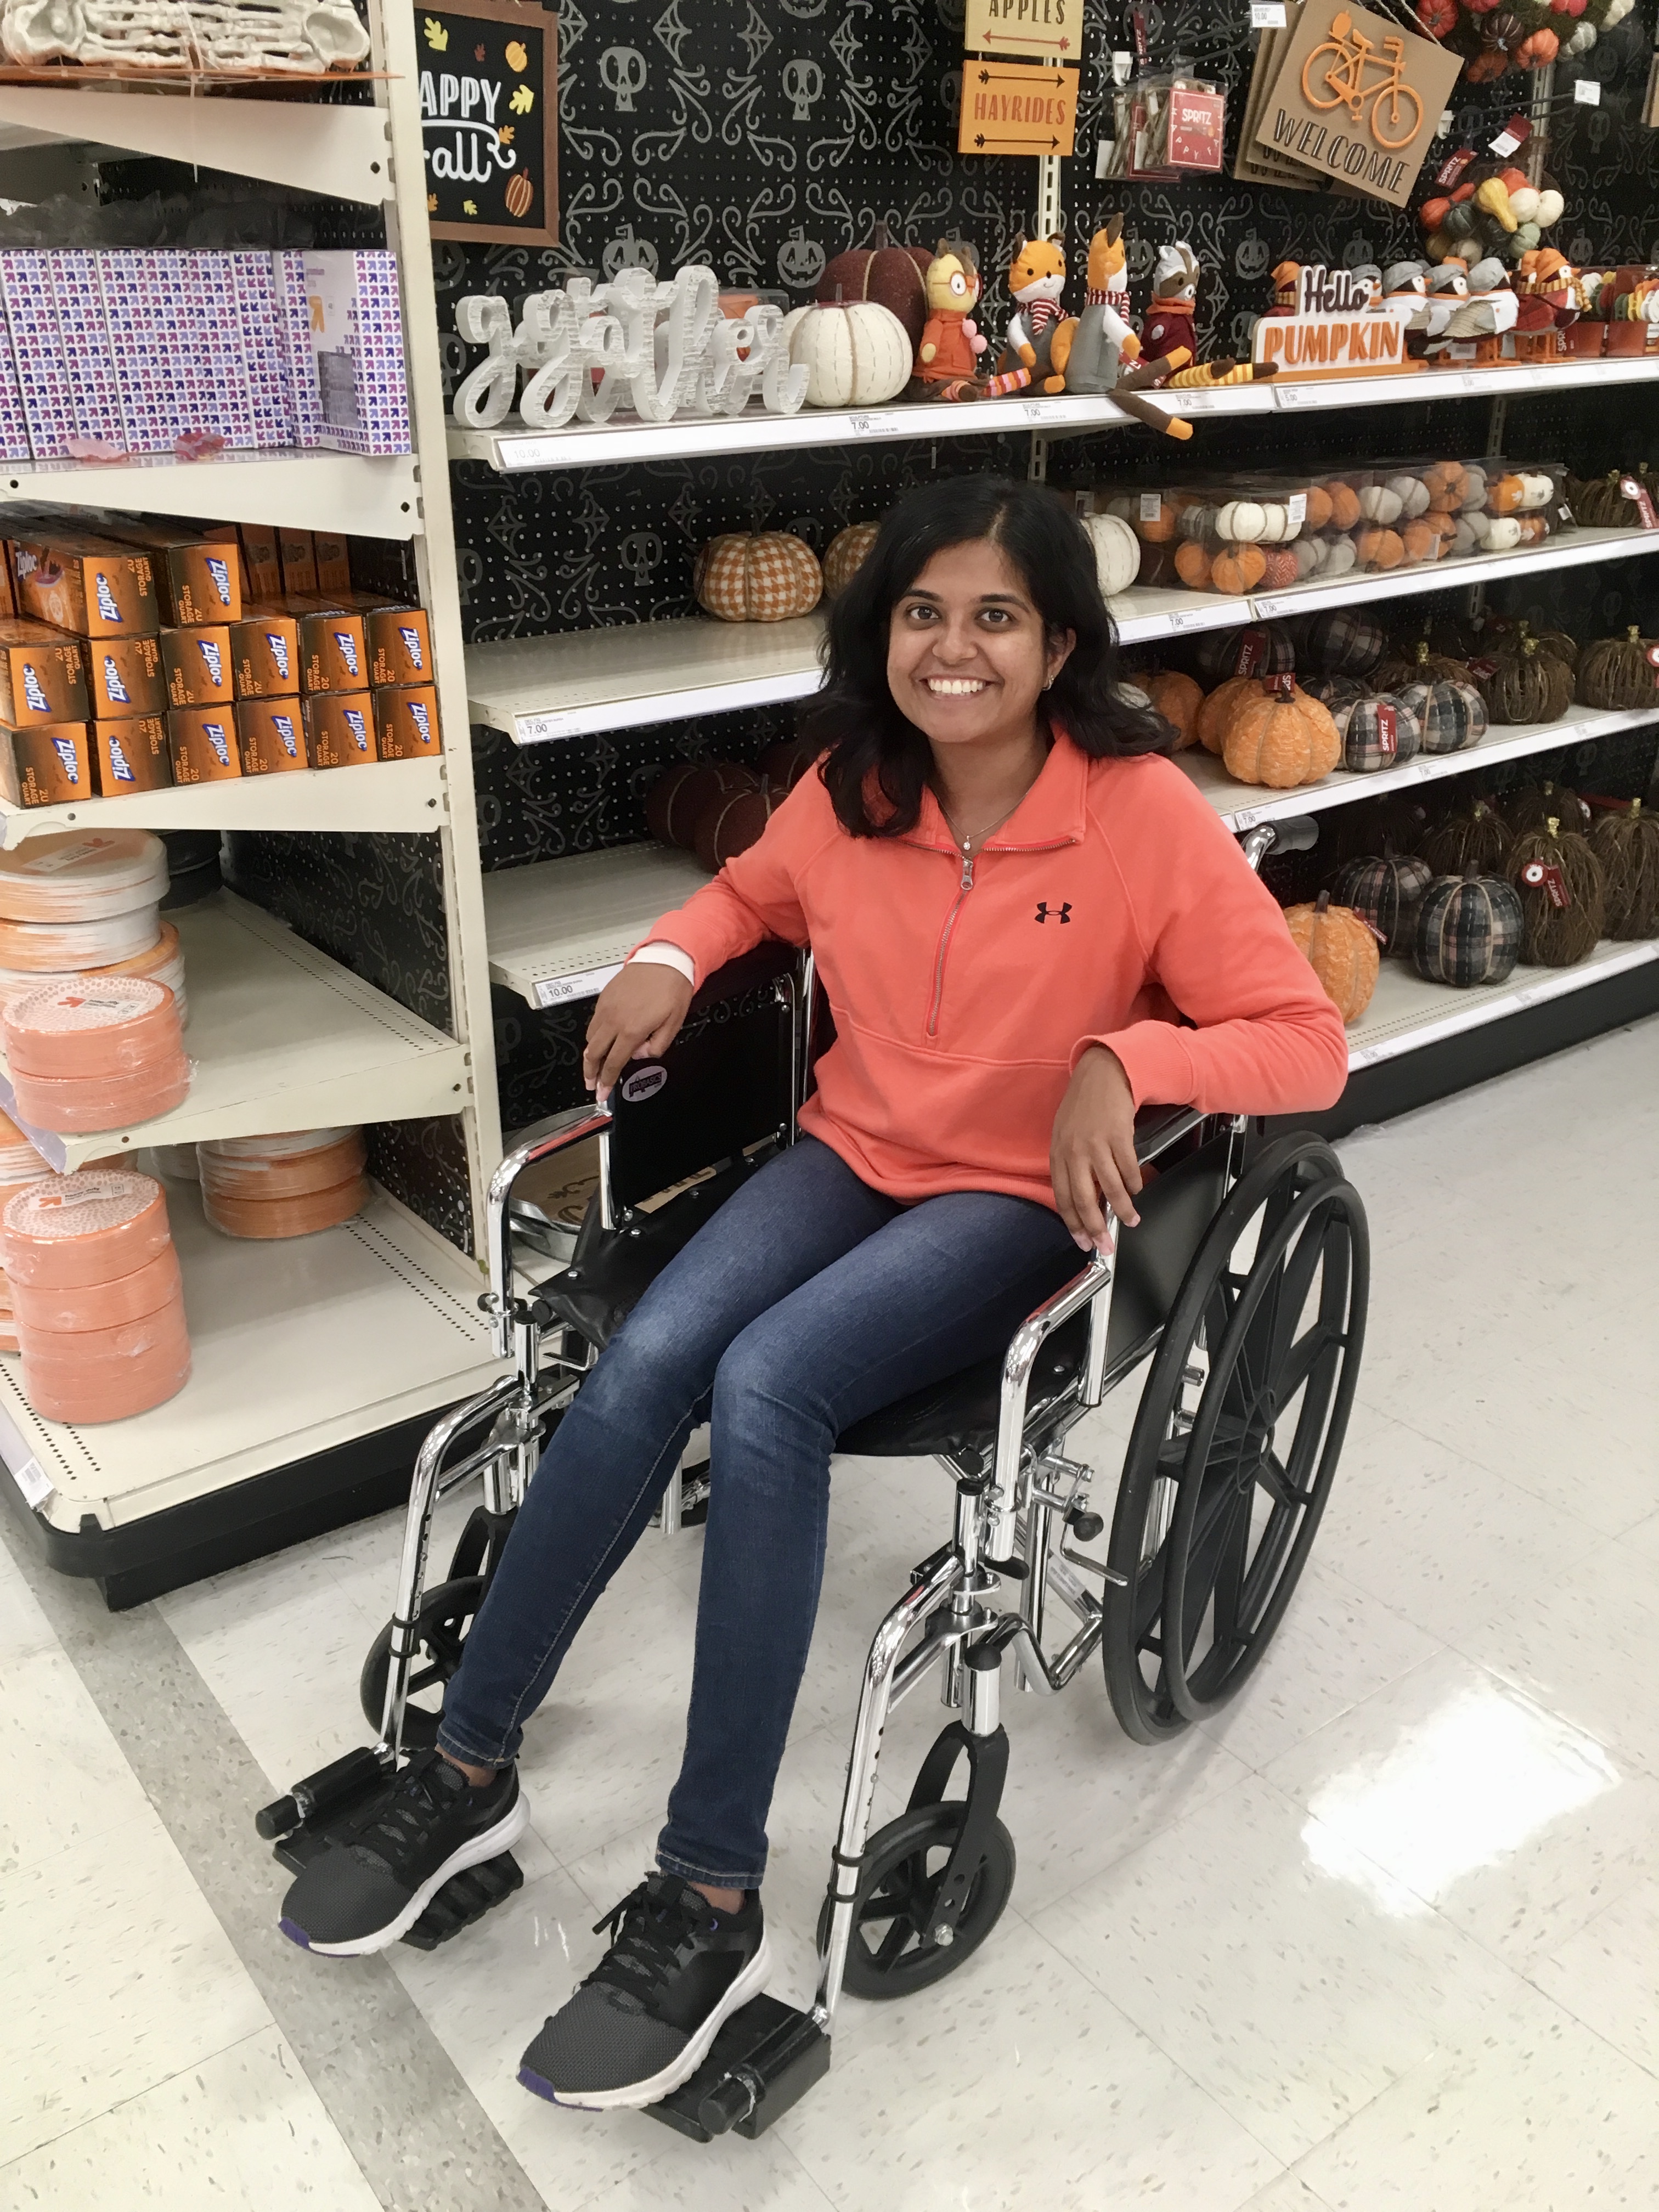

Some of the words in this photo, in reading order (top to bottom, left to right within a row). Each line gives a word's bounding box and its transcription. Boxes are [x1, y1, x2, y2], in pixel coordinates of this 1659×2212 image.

[989, 0, 1065, 24] APPLES
[419, 70, 501, 123] APPY
[974, 93, 1066, 125] HAYRIDES
[1182, 109, 1212, 125] SPRITZ
[1273, 109, 1410, 194] WELCOME
[1438, 156, 1461, 185] SPRITZ
[1305, 269, 1369, 312] Hello
[1263, 321, 1400, 364] PUMPKIN
[851, 421, 870, 430] 7.00
[514, 449, 540, 459] 10.00
[16, 551, 37, 579] Ziploc
[136, 557, 147, 597] STORAGE
[143, 557, 151, 582] QUART
[209, 560, 230, 602] Ziploc
[97, 575, 119, 620] Ziploc
[178, 600, 188, 624] QUART
[182, 584, 194, 623] STORAGE
[1170, 618, 1184, 627] 7.00
[64, 646, 76, 685] STORAGE
[71, 645, 81, 670] QUART
[143, 640, 155, 678] STORAGE
[150, 639, 159, 662] QUART
[201, 642, 222, 684] Ziploc
[269, 635, 289, 676] Ziploc
[338, 633, 358, 674] Ziploc
[377, 647, 387, 683] STORAGE
[402, 628, 422, 668] Ziploc
[1238, 644, 1254, 675] SPRITZ
[23, 668, 46, 710] Ziploc
[104, 658, 126, 702] Ziploc
[174, 668, 186, 705] STORAGE
[239, 673, 247, 697] QUART
[242, 659, 255, 696] STORAGE
[312, 654, 320, 691] STORAGE
[321, 676, 329, 690] 20
[387, 669, 396, 682] 20
[170, 682, 179, 706] QUART
[149, 718, 160, 755] STORAGE
[155, 716, 164, 741] QUART
[275, 716, 297, 755] Ziploc
[347, 710, 368, 749] Ziploc
[386, 723, 394, 758] STORAGE
[411, 703, 431, 742] Ziploc
[527, 723, 548, 734] 7.00
[1381, 719, 1390, 752] SPRITZ
[56, 739, 78, 781] Ziploc
[109, 738, 131, 780] Ziploc
[207, 724, 229, 764] Ziploc
[249, 736, 259, 773] STORAGE
[321, 730, 330, 766] STORAGE
[330, 752, 339, 765] 20
[394, 744, 403, 757] 20
[180, 746, 190, 783] STORAGE
[190, 768, 199, 781] 20
[259, 758, 268, 771] 20
[21, 782, 31, 806] QUART
[26, 766, 39, 805] STORAGE
[1243, 815, 1256, 824] 7.00
[1547, 878, 1563, 906] SPRITZ
[549, 985, 573, 997] 10.00
